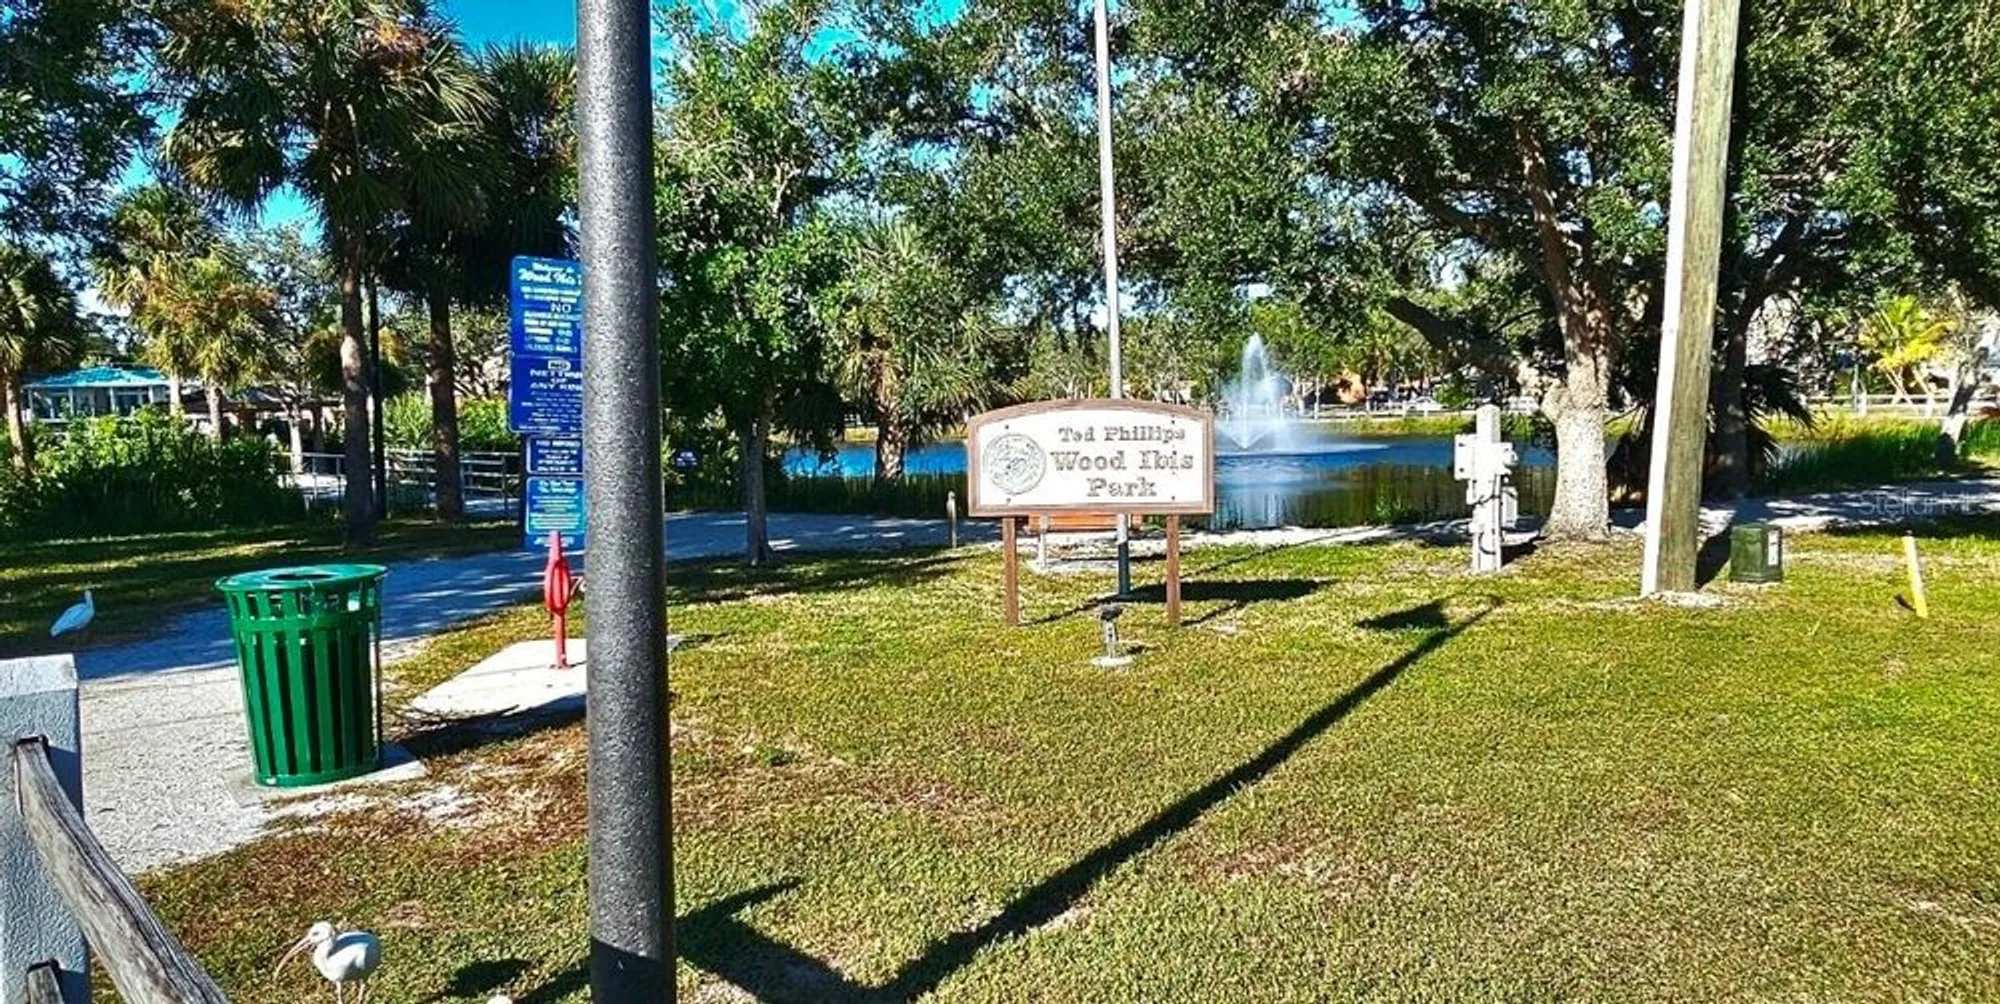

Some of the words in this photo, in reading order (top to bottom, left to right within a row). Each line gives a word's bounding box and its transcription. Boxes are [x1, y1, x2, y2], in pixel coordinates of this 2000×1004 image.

[550, 303, 571, 313] NO
[1058, 426, 1095, 442] Ted
[1104, 426, 1186, 444] Phillips
[1050, 450, 1127, 471] Wood
[1139, 450, 1194, 470] Ibis
[1086, 477, 1157, 498] Park
